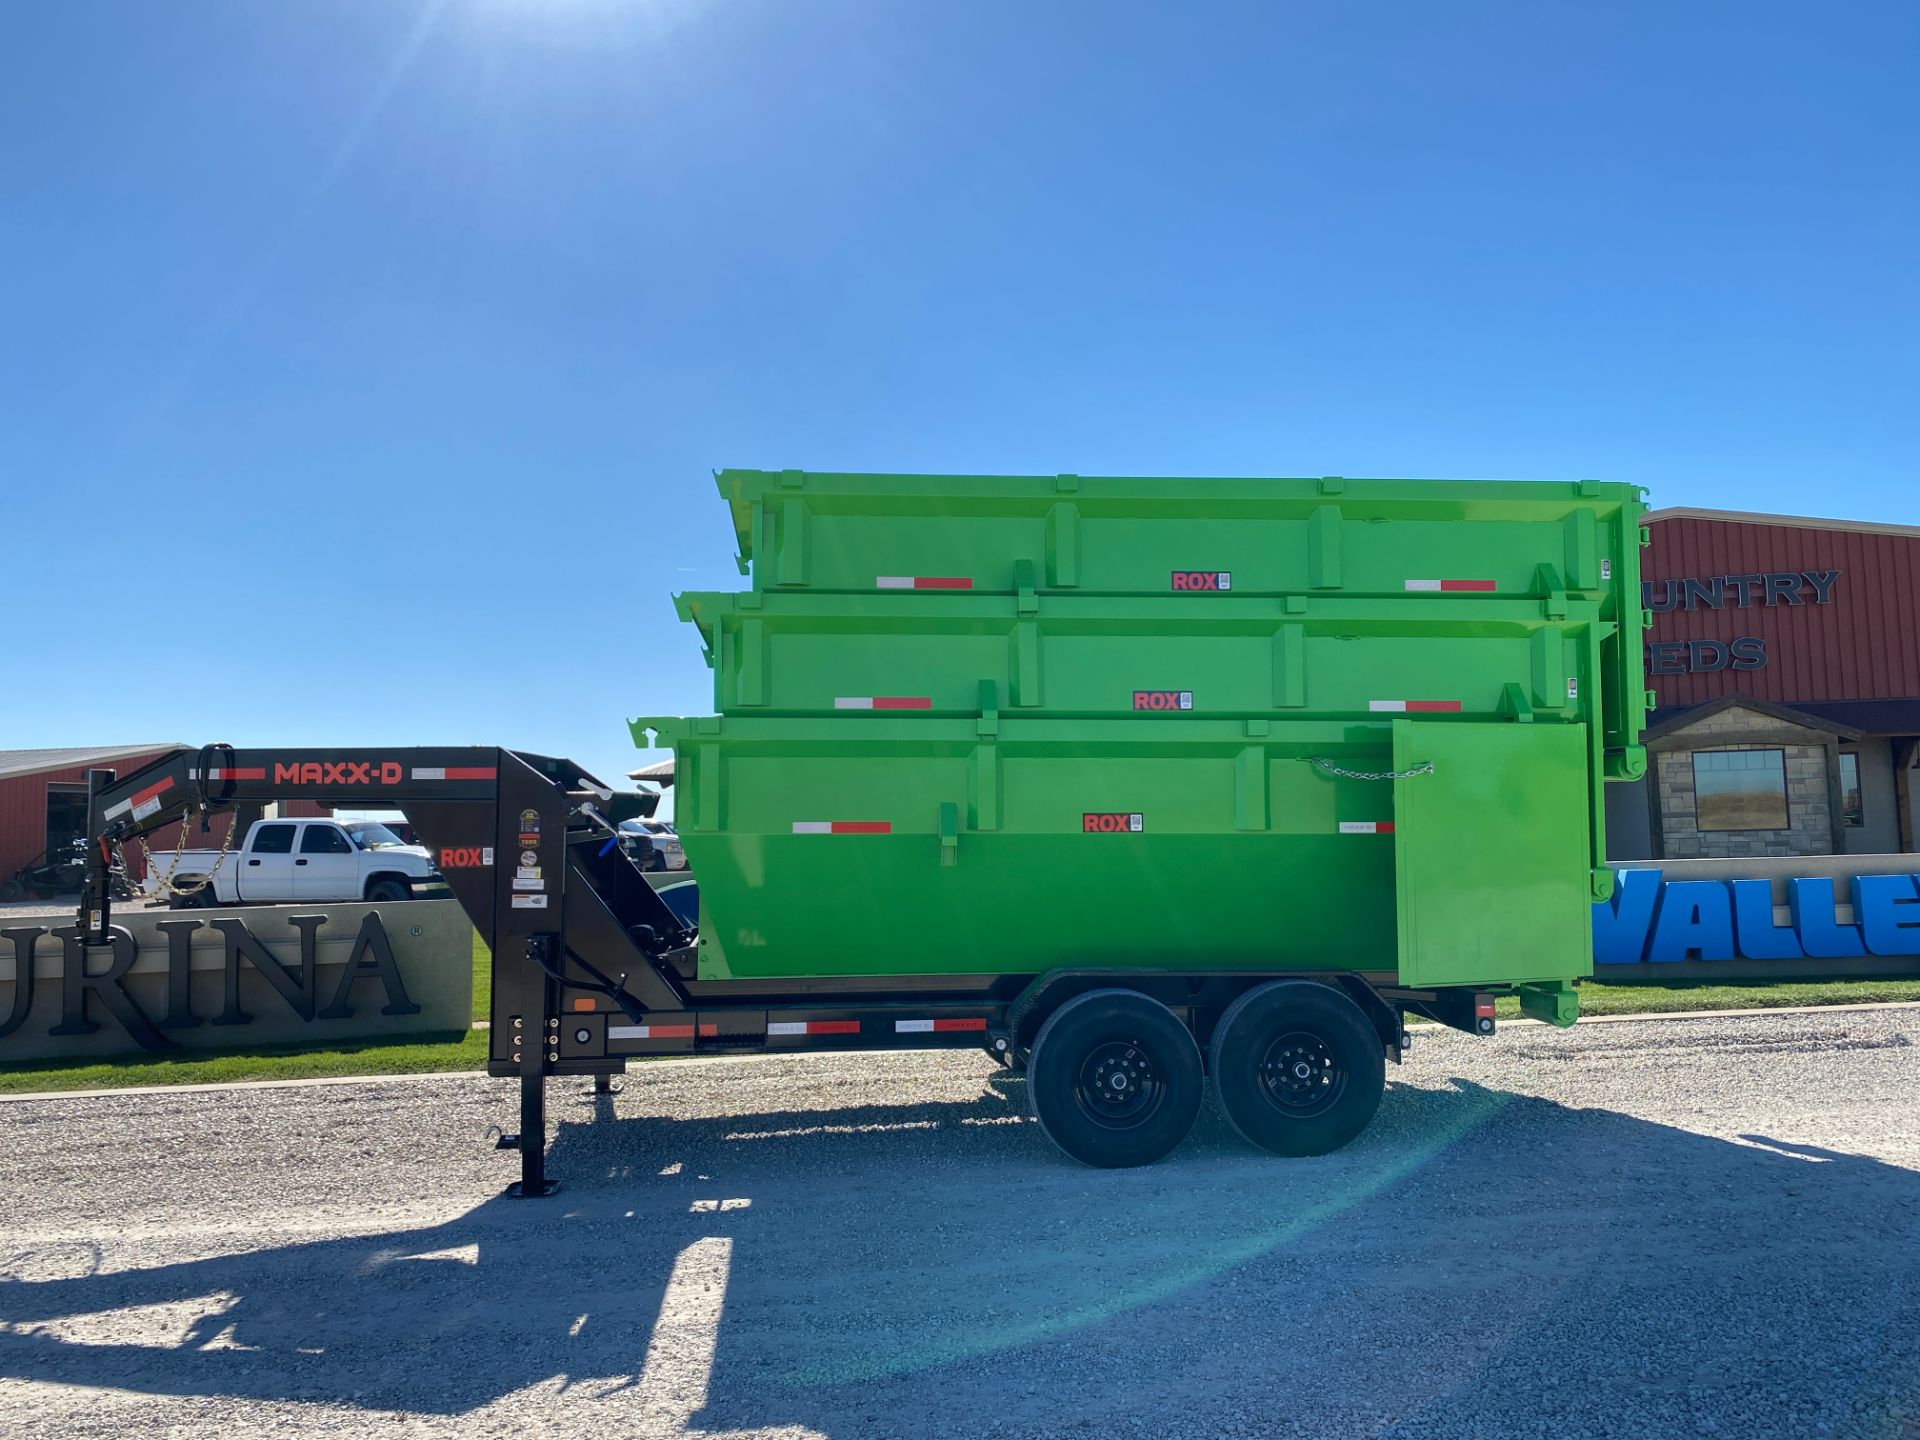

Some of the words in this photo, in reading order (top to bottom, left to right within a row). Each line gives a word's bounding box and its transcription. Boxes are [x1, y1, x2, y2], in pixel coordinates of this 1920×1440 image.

[1174, 572, 1217, 590] ROX
[1641, 570, 1841, 613] UNTRY
[1643, 637, 1768, 676] EDS
[1134, 692, 1179, 710] ROX
[274, 762, 402, 785] MAXX-D
[1084, 814, 1129, 832] ROX
[441, 848, 481, 867] ROX
[1592, 869, 1920, 964] VALLE
